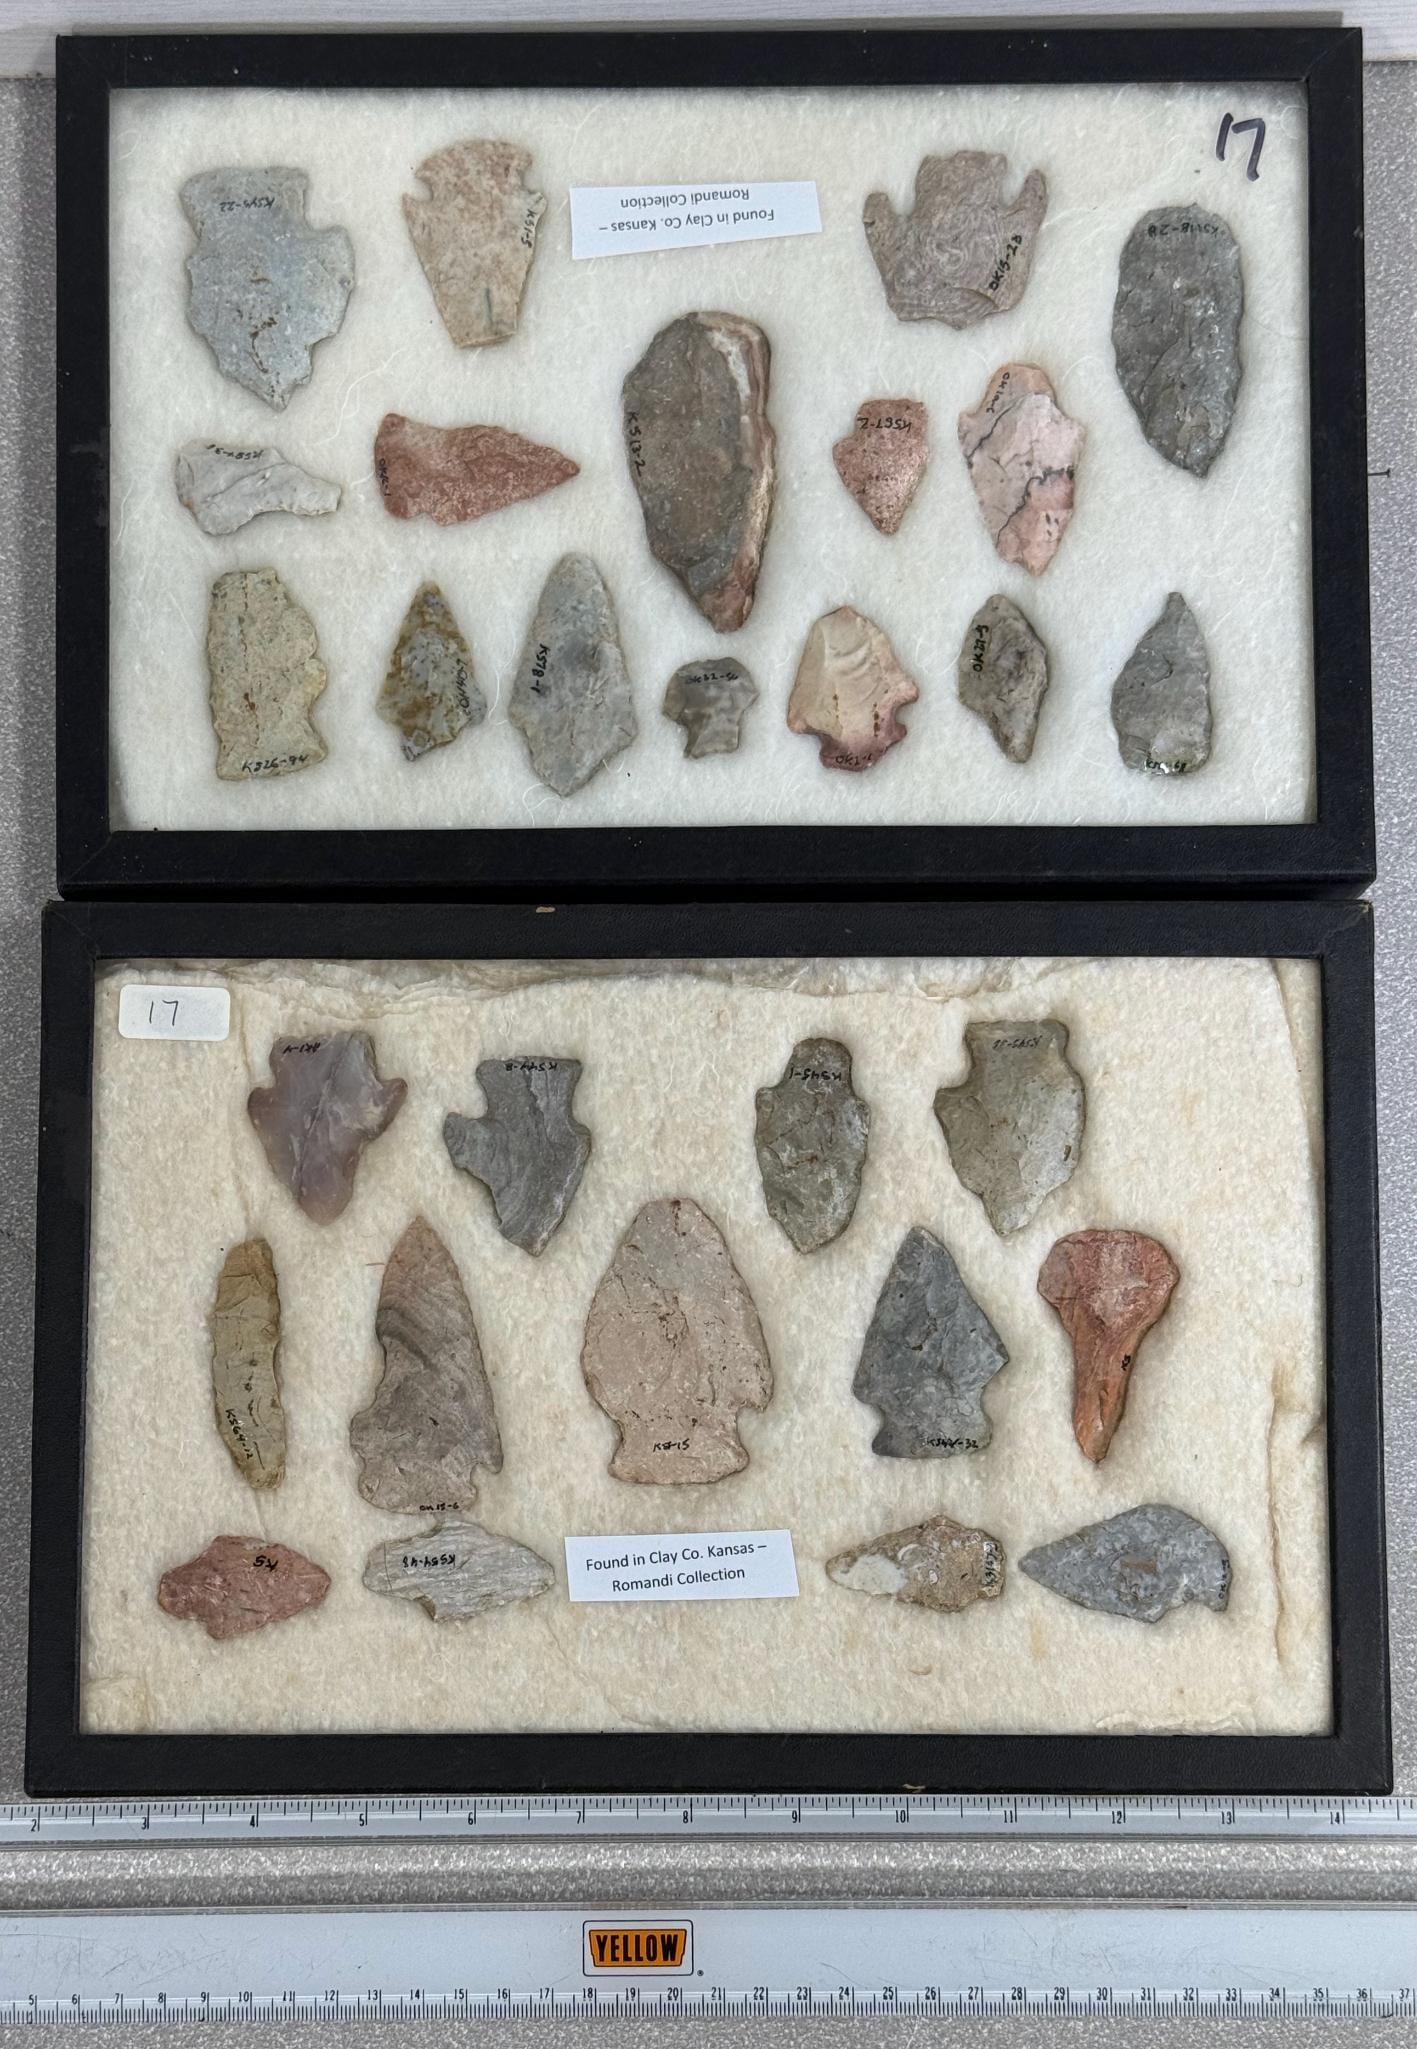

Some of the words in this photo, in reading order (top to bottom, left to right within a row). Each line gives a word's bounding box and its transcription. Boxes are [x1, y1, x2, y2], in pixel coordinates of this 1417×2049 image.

[1215, 112, 1266, 181] 17
[620, 194, 687, 208] Collection
[690, 188, 750, 202] Romandi
[660, 217, 682, 230] Co.
[685, 213, 713, 229] Clay
[717, 212, 730, 224] in
[733, 209, 775, 224] Found
[610, 219, 657, 232] Kansas
[149, 1001, 181, 1026] 17
[586, 1554, 629, 1571] Found
[633, 1553, 646, 1566] in
[649, 1550, 678, 1564] Clay
[682, 1548, 704, 1560] Co.
[707, 1543, 755, 1558] Kansas
[612, 1574, 673, 1592] Romandi
[677, 1567, 745, 1585] Collection
[31, 1819, 37, 1831] 2
[141, 1817, 146, 1829] 3
[250, 1815, 256, 1828] 4
[360, 1814, 365, 1826] 5
[468, 1812, 474, 1825] 6
[576, 1811, 582, 1823] 7
[682, 1810, 688, 1822] 8
[792, 1811, 798, 1823] 9
[896, 1810, 906, 1823] 10
[1004, 1810, 1014, 1823] 11
[1112, 1811, 1122, 1824] 12
[1221, 1811, 1232, 1824] 13
[1330, 1811, 1340, 1824] 14
[595, 1934, 678, 1962] YELLOW
[29, 1995, 34, 2005] 5
[72, 1994, 77, 2004] 6
[115, 1993, 120, 2004] 7
[158, 1992, 164, 2003] 8
[200, 1992, 206, 2002] 9
[238, 1992, 249, 2002] 10
[283, 1991, 292, 2002] 11
[324, 1990, 335, 2001] 12
[368, 1990, 378, 2000] 13
[410, 1990, 420, 2000] 14
[454, 1989, 464, 2000] 15
[497, 1988, 508, 2000] 16
[540, 1988, 550, 2000] 17
[582, 1988, 594, 2000] 18
[625, 1988, 636, 2000] 19
[667, 1988, 679, 2000] 20
[711, 1987, 722, 2000] 21
[753, 1987, 765, 2000] 22
[796, 1987, 808, 2000] 23
[838, 1987, 850, 2000] 24
[882, 1987, 894, 2000] 25
[925, 1987, 936, 2000] 26
[968, 1987, 979, 2000] 27
[1012, 1987, 1023, 2000] 28
[1054, 1987, 1065, 2000] 29
[1096, 1987, 1108, 2000] 30
[1140, 1987, 1151, 2000] 31
[1182, 1988, 1194, 2000] 32
[1226, 1988, 1237, 2000] 33
[1269, 1988, 1280, 2000] 34
[1313, 1988, 1324, 2001] 35
[1356, 1988, 1368, 2000] 36
[1398, 1988, 1410, 2000] 37
